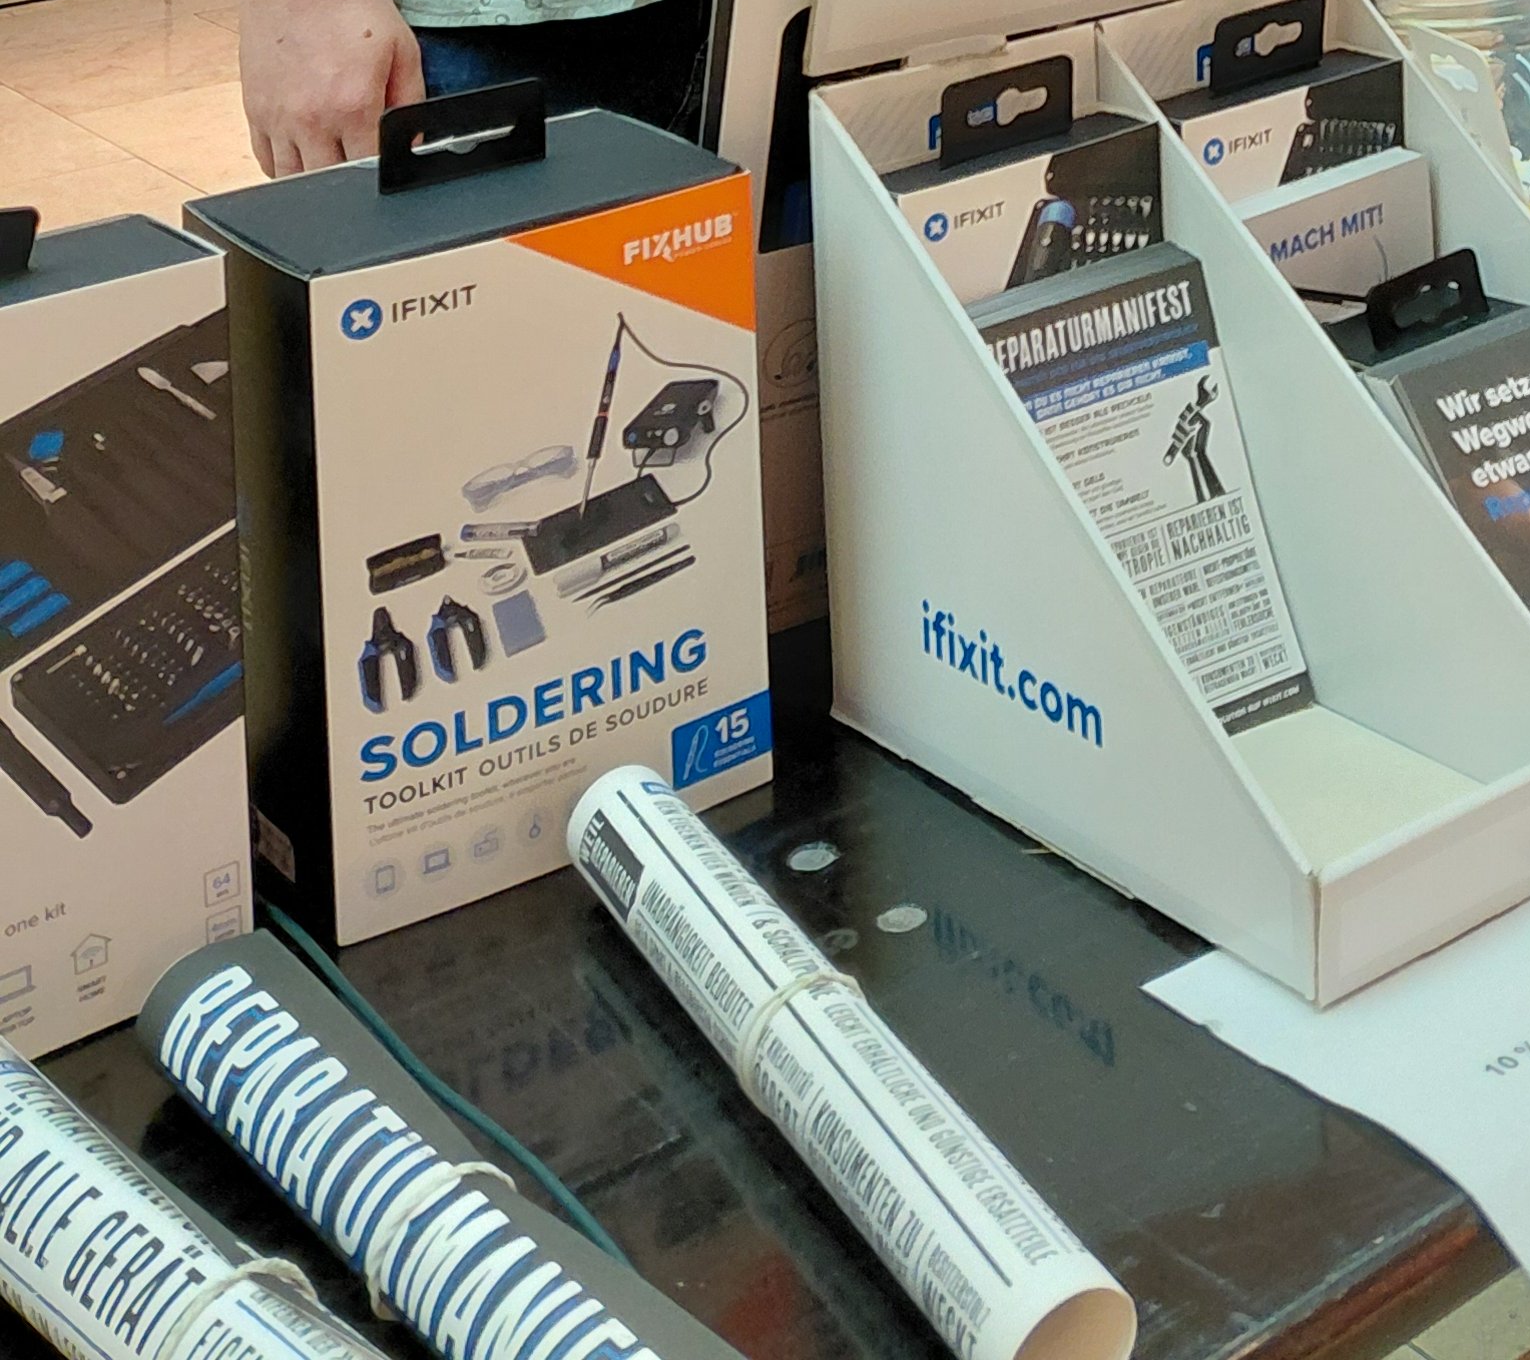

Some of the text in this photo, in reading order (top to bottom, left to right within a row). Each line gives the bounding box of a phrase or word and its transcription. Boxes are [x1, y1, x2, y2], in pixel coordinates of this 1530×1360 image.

[1228, 128, 1272, 155] IFIXIT
[623, 213, 733, 265] FIXHUB
[953, 201, 1005, 230] IFIXIT
[1270, 203, 1383, 263] MACH MIT!
[391, 284, 478, 323] IFIXIT
[1436, 390, 1482, 422] Wir
[1166, 503, 1227, 539] REPARIEREN
[1227, 496, 1244, 518] IST
[1170, 514, 1251, 561] NACHHALTIG
[922, 599, 1102, 748] ifixit.com
[359, 628, 708, 782] SOLDERING
[715, 707, 749, 743] 15
[363, 677, 709, 815] TOOLKIT OUTILS DE SOUDURE
[578, 814, 607, 864] WEIL
[212, 873, 231, 889] 64
[4, 902, 67, 937] one kit
[631, 879, 721, 973] UNABHÄNGIGKEIT
[695, 960, 761, 1029] BEDEUTET
[1485, 1055, 1519, 1076] 10
[849, 1028, 926, 1110] ERHÄLTLICHE
[905, 1096, 946, 1137] UND
[926, 1119, 997, 1194] GÜNSTIGE
[976, 1181, 1058, 1266] ERSATZTEILE
[793, 1100, 918, 1231] KONSUMENTEN
[887, 1210, 934, 1256] ZU
[0, 1149, 208, 1356] ALLE GERÄT
